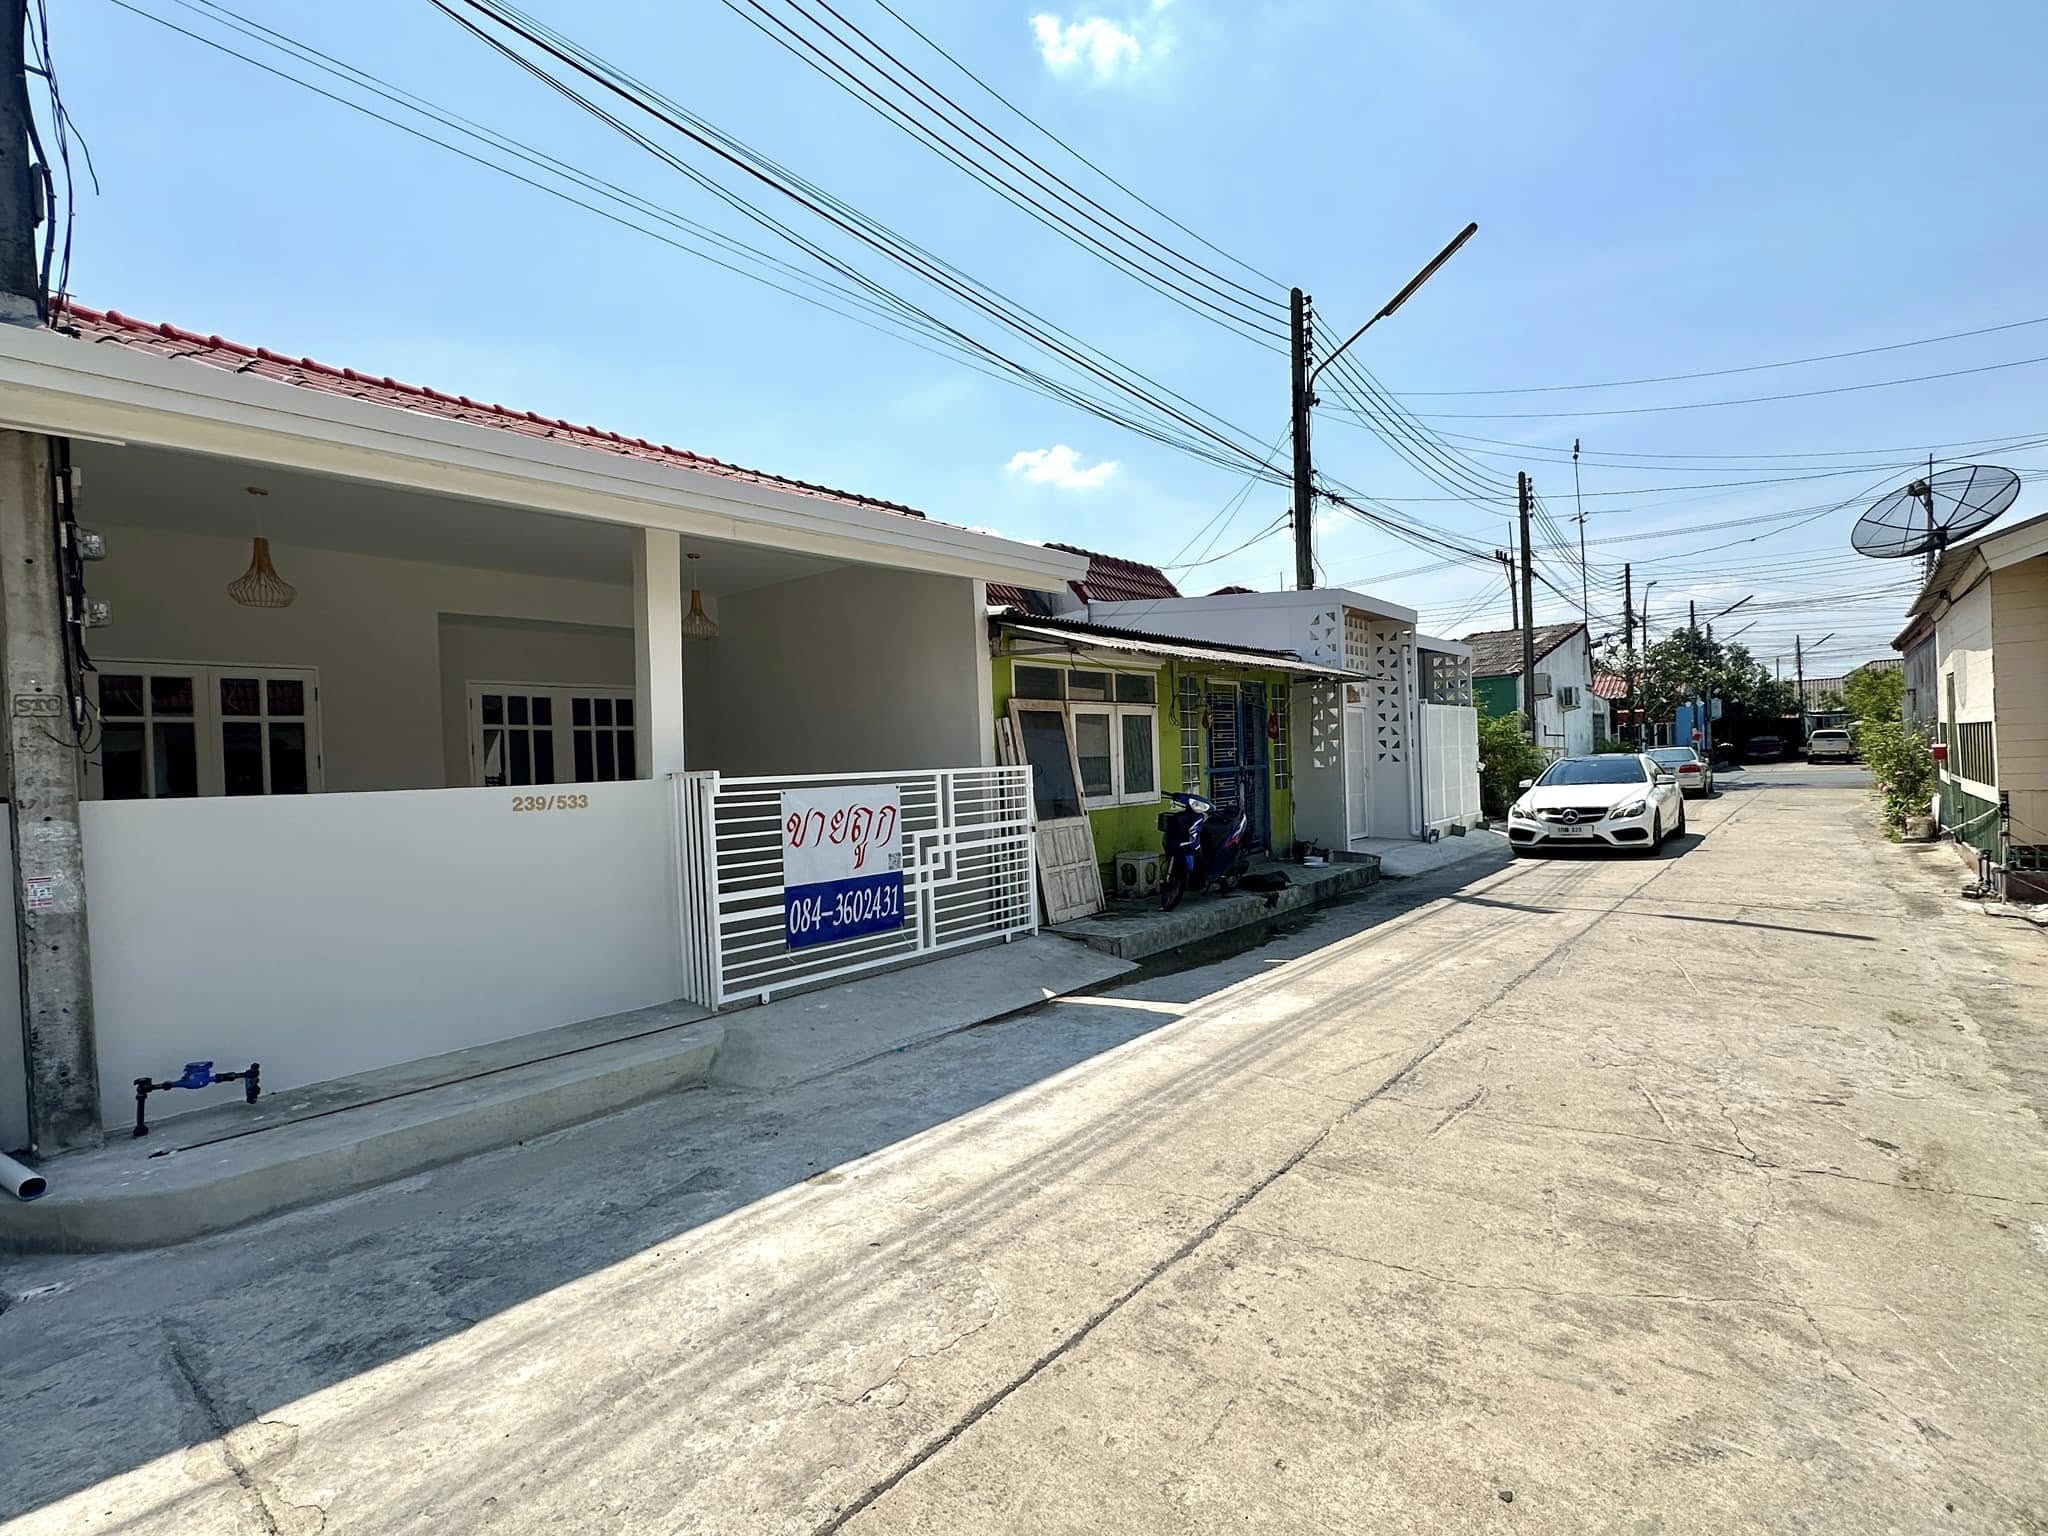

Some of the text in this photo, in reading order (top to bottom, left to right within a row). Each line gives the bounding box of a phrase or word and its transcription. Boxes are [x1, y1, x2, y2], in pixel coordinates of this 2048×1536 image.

[511, 794, 589, 812] 239/533
[786, 803, 897, 869] ขายถูก
[789, 884, 899, 935] 084-3602431
